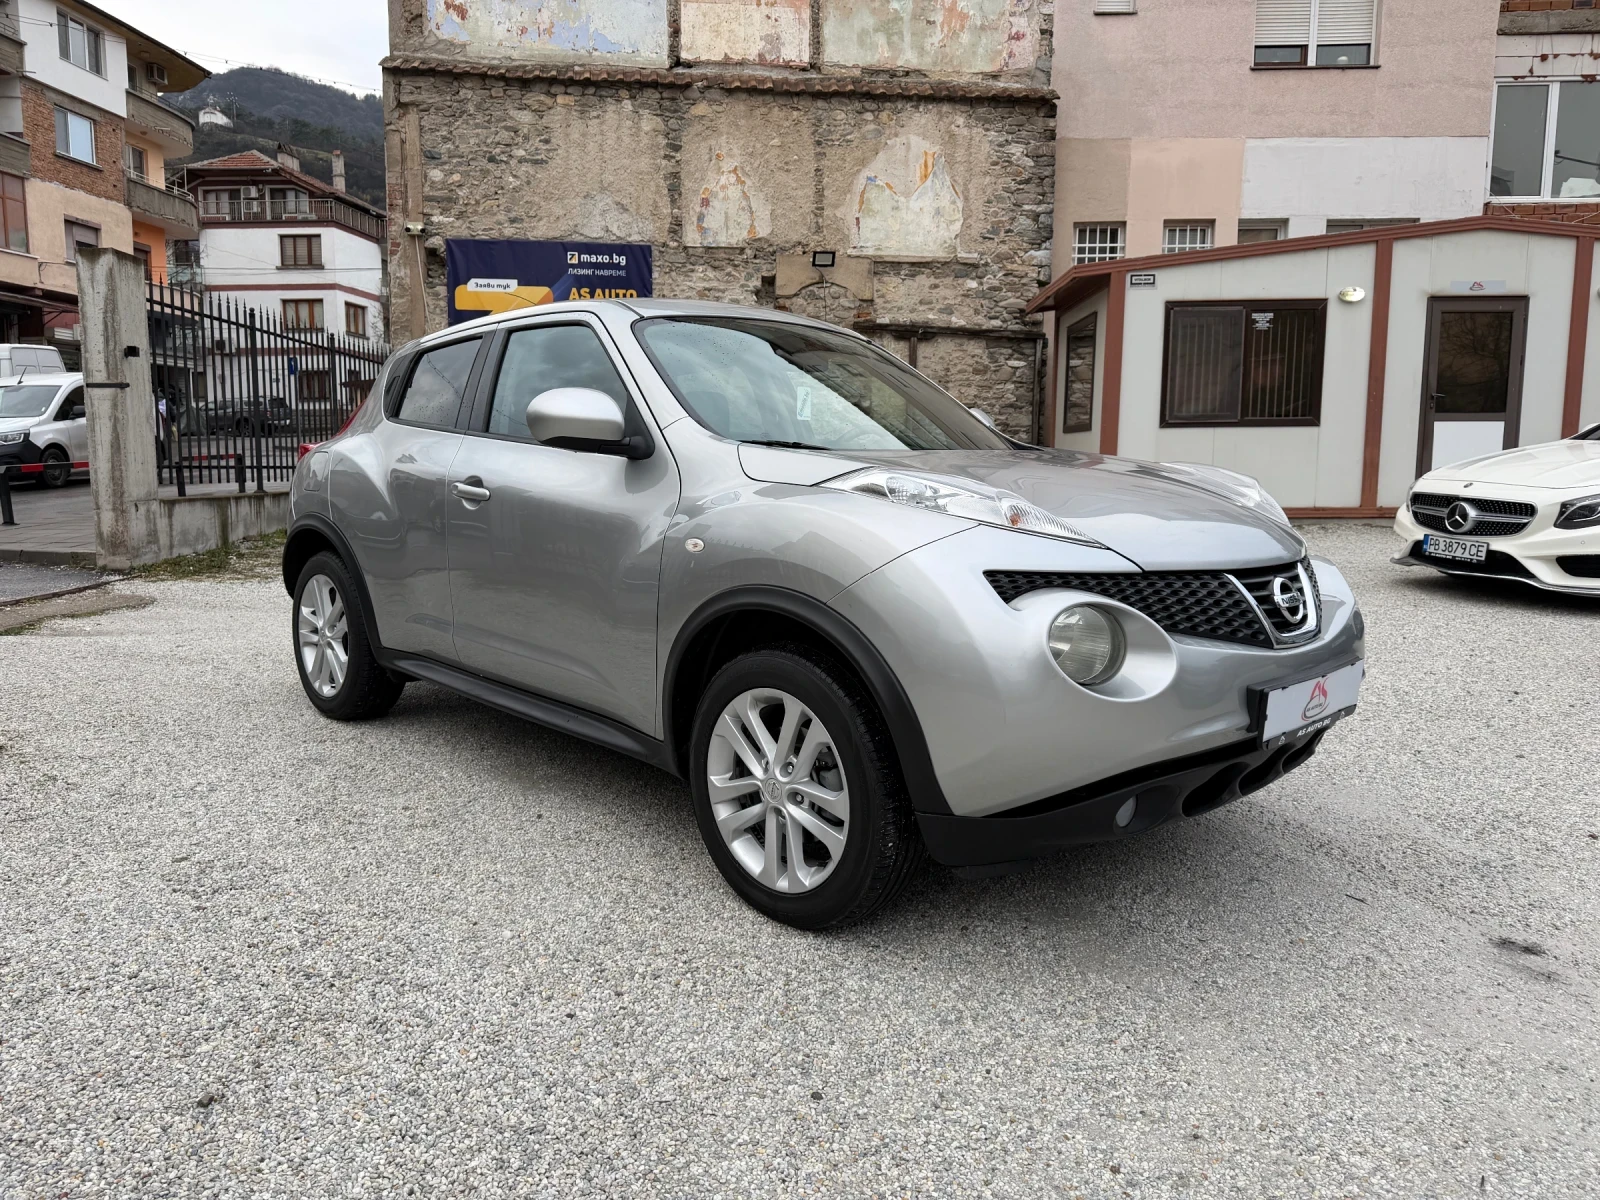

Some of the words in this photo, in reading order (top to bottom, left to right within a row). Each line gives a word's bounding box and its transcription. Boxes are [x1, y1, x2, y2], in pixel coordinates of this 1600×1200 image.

[581, 253, 626, 266] maxo.bg
[569, 287, 591, 300] AS
[1428, 538, 1440, 550] PB
[1441, 540, 1467, 555] 3879
[1468, 544, 1484, 558] CE
[1296, 727, 1306, 737] AS
[1306, 721, 1323, 733] AUTO
[1323, 717, 1332, 726] BG
